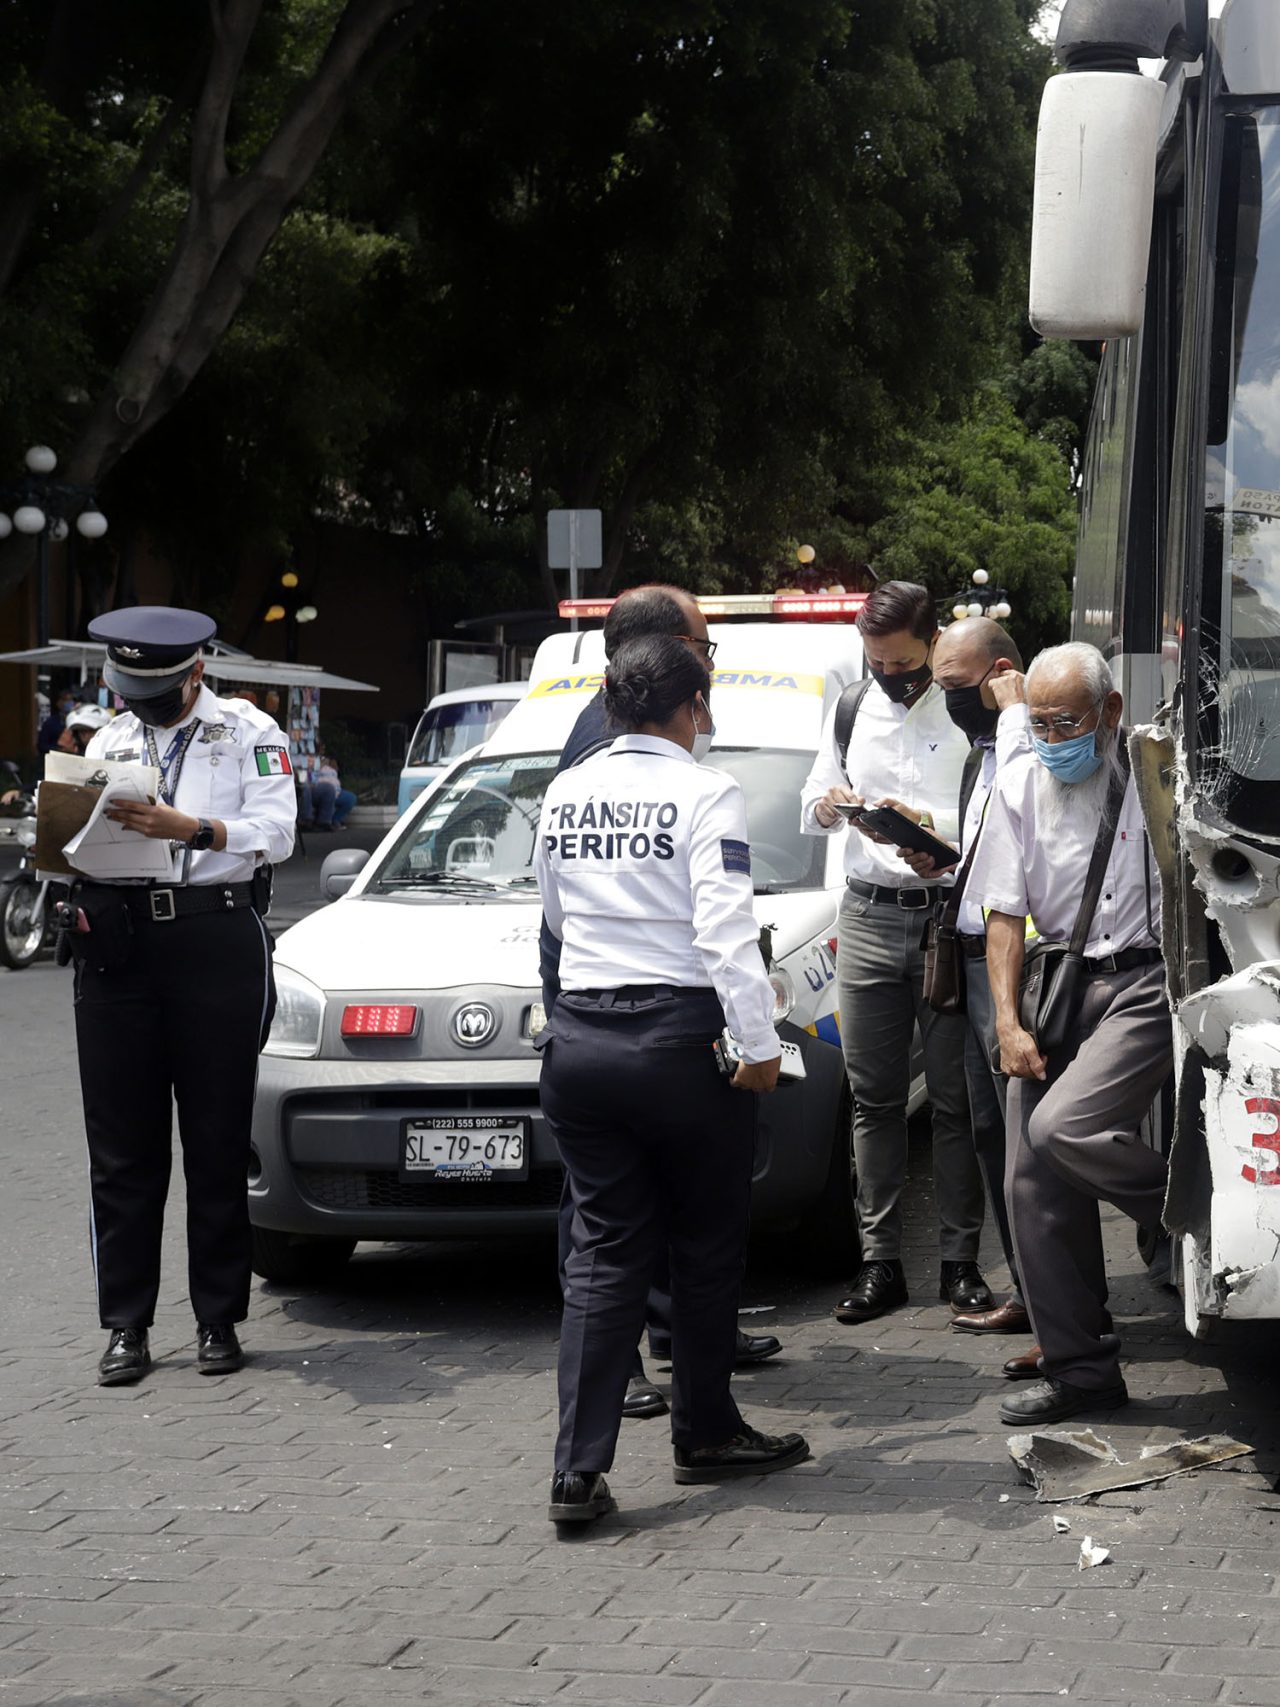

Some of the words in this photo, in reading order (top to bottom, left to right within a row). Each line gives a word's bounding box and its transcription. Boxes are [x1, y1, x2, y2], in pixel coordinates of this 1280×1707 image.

[548, 795, 678, 830] TRÁNSITO
[545, 832, 675, 861] PERITOS
[432, 1118, 455, 1129] (222)
[457, 1118, 474, 1129] 555
[475, 1118, 498, 1128] 9900
[406, 1134, 523, 1162] SL-79-673
